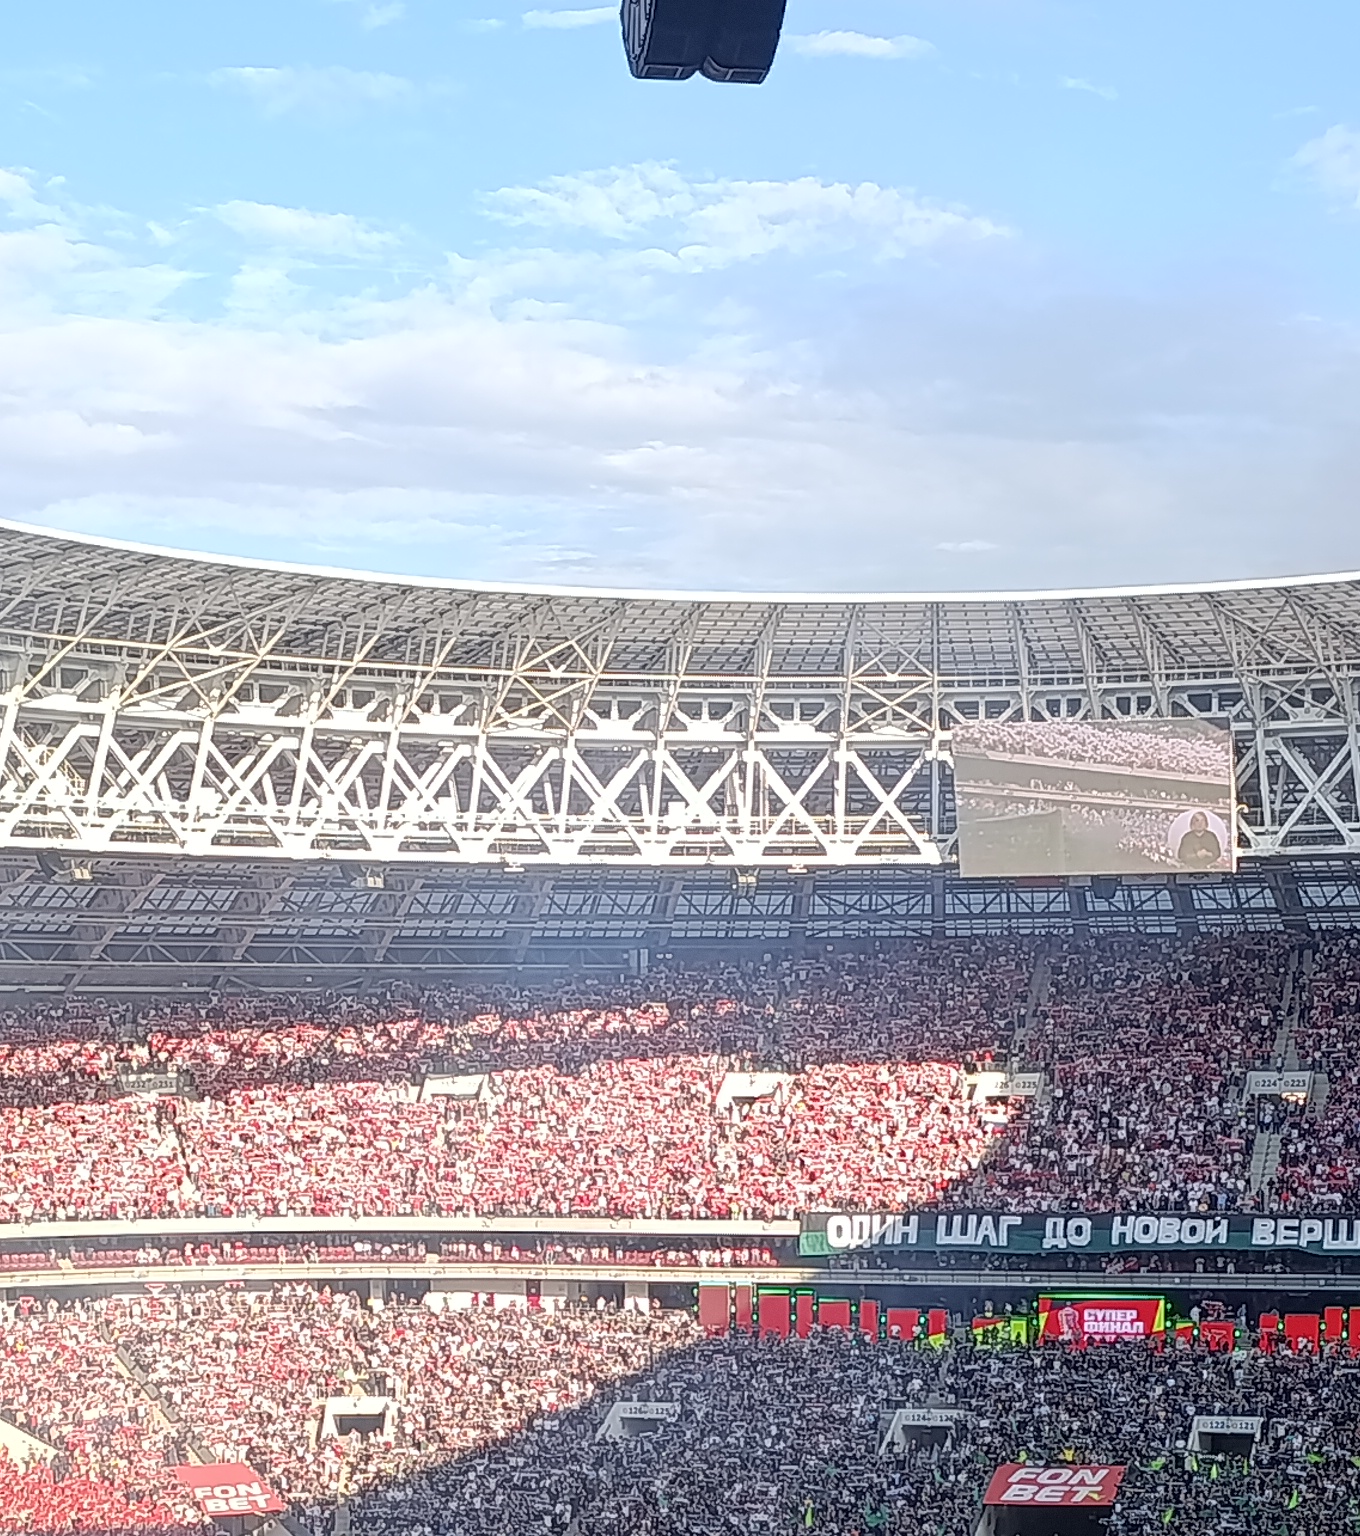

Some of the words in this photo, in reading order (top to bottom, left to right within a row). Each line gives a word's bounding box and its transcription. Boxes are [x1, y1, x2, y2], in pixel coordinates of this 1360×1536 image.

[826, 1214, 919, 1249] ОДИН
[936, 1213, 1022, 1247] ШАГ
[1042, 1216, 1092, 1249] ДО
[1111, 1214, 1229, 1246] НОВОЙ
[1083, 1308, 1138, 1321] СУПЕР
[1083, 1320, 1145, 1335] ФИНАЛ
[1007, 1468, 1110, 1485] FON
[193, 1481, 262, 1499] FON
[999, 1485, 1105, 1502] BET
[204, 1494, 271, 1512] BET
